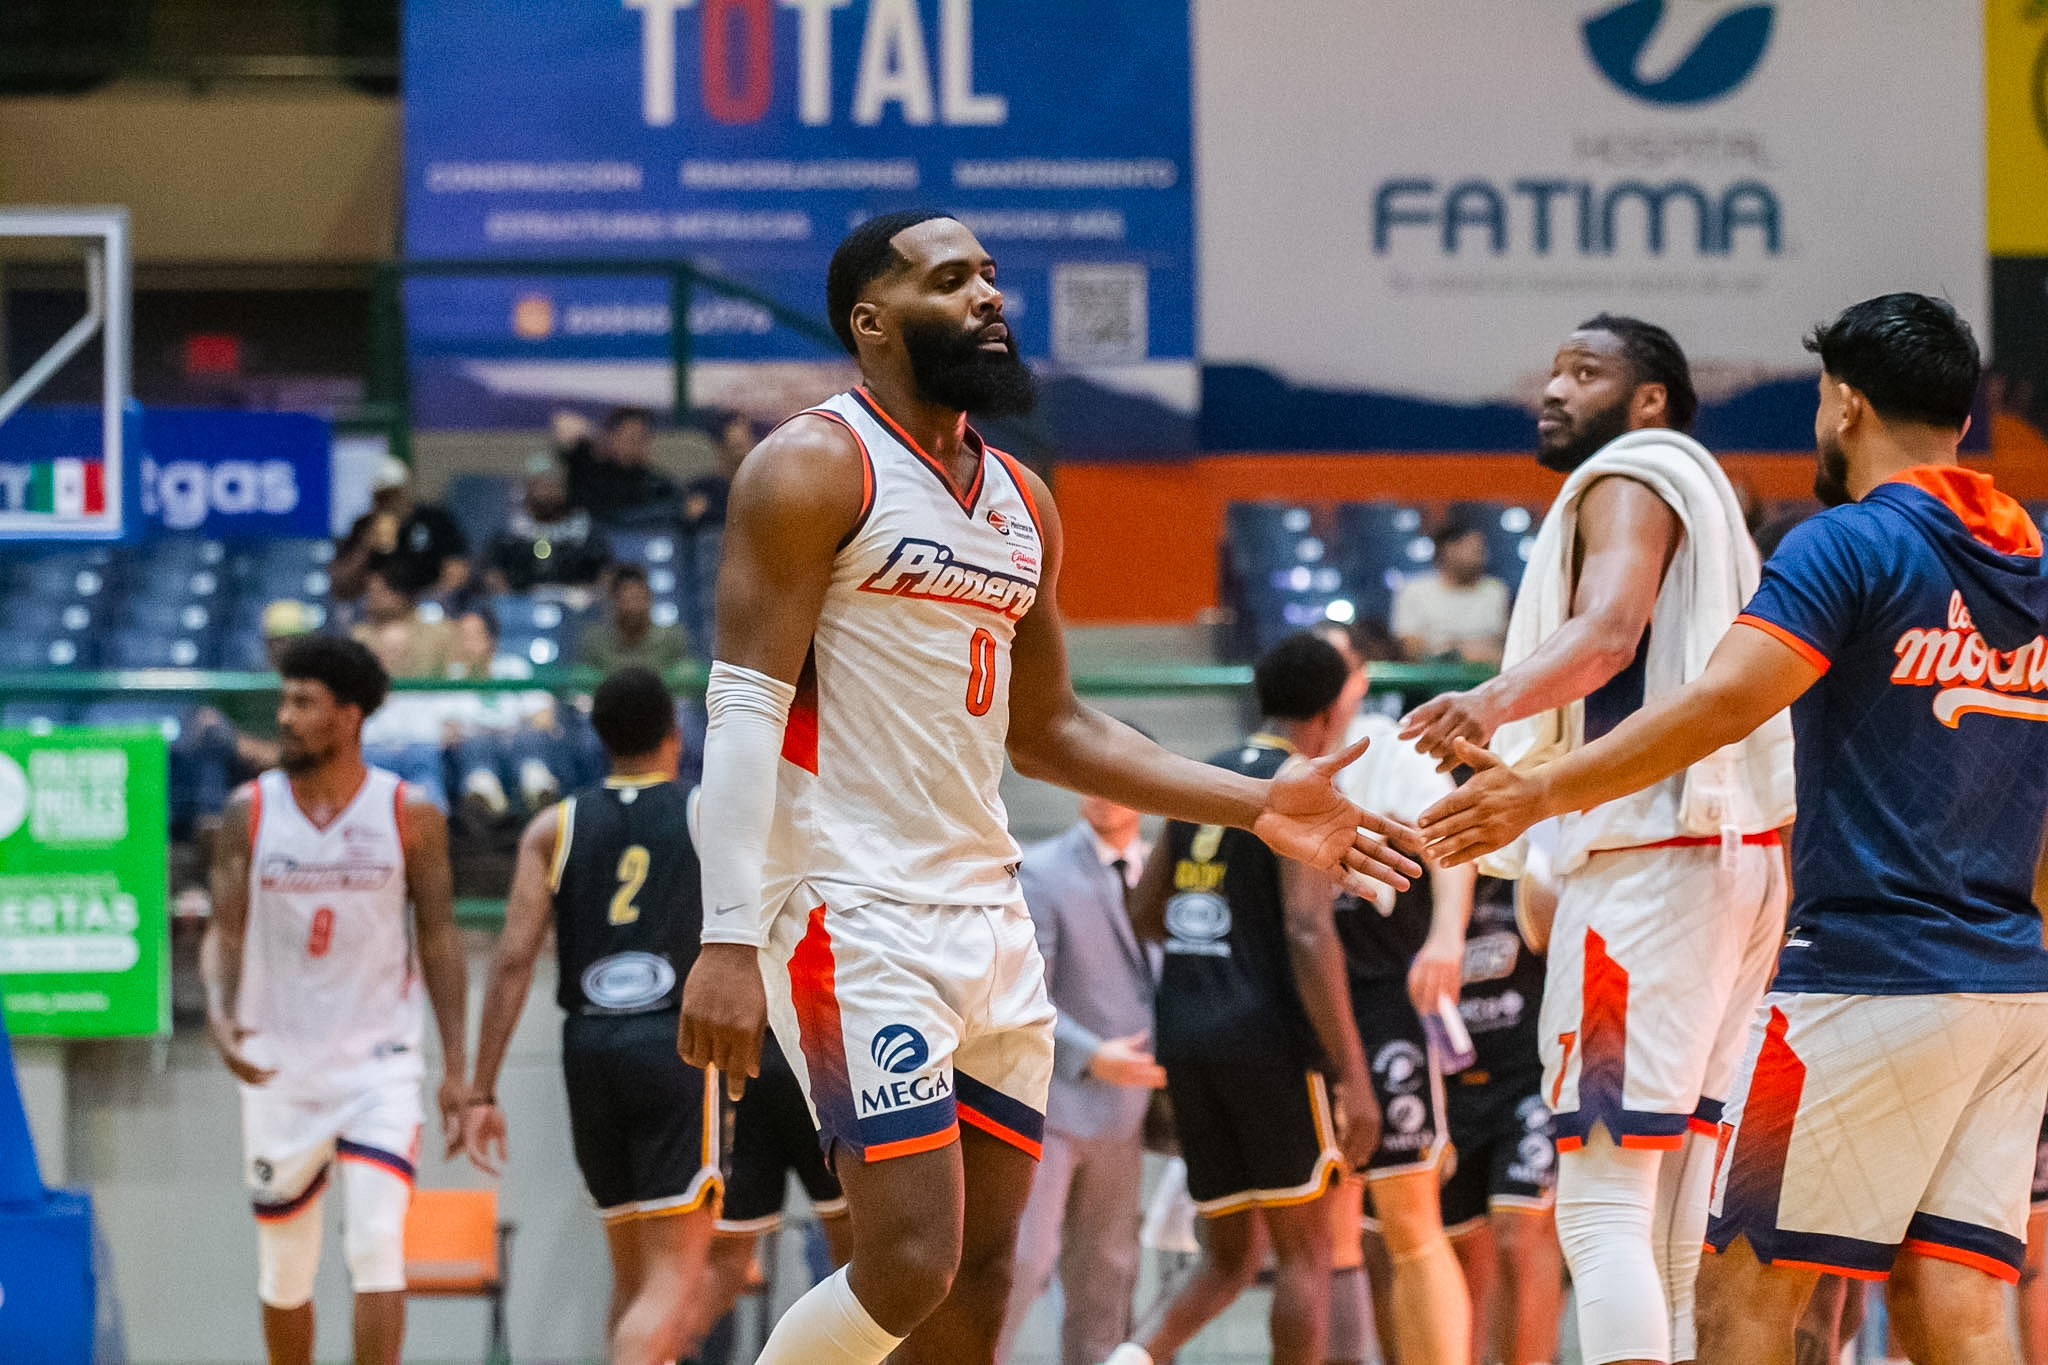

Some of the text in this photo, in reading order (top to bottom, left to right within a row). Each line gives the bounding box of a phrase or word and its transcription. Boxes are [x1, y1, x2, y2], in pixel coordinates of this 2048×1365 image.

[622, 0, 1008, 126] TOTAL
[1372, 177, 1784, 256] FATIMA
[965, 627, 996, 717] 0
[607, 844, 650, 926] 2
[861, 1071, 949, 1114] MEGA
